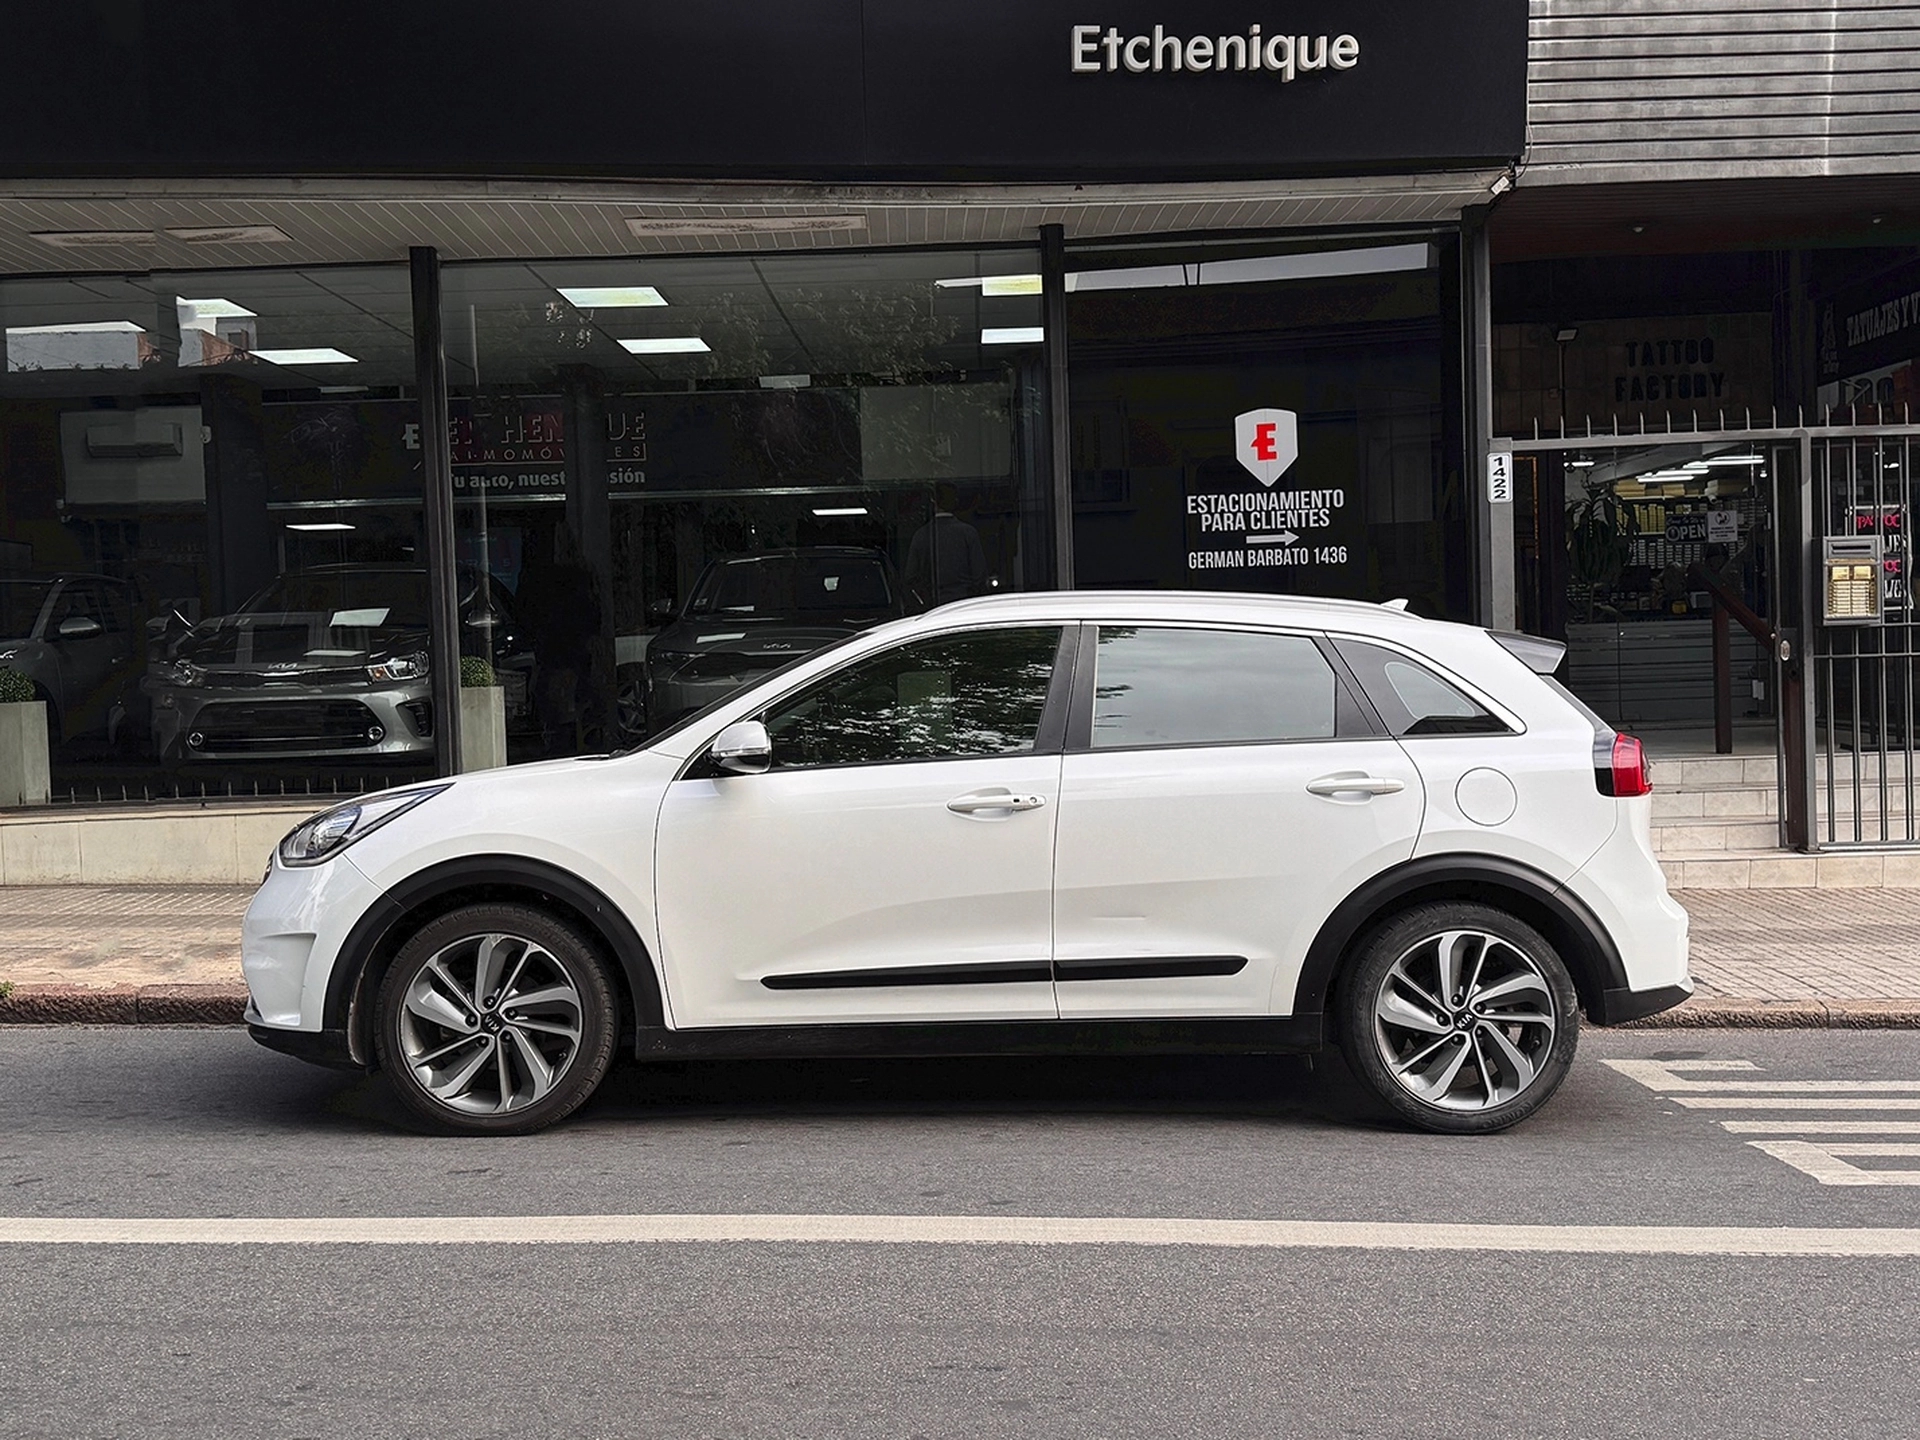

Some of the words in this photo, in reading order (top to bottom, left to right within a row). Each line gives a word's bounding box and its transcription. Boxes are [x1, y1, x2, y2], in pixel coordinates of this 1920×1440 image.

[1071, 24, 1360, 83] Etchenique
[1845, 299, 1900, 348] TATUAJES
[1625, 337, 1714, 367] TATTOO
[1615, 372, 1724, 401] FACTORY
[518, 470, 567, 487] nuest
[1493, 456, 1506, 499] 1422
[1187, 489, 1344, 514] ESTACIONAMIENTO
[1201, 512, 1246, 532] PARA
[1250, 508, 1330, 530] CLIENTES
[1665, 524, 1706, 541] OPEN
[1188, 550, 1244, 569] GERMAN
[1248, 547, 1309, 567] BARBATO
[1313, 546, 1347, 565] 1436
